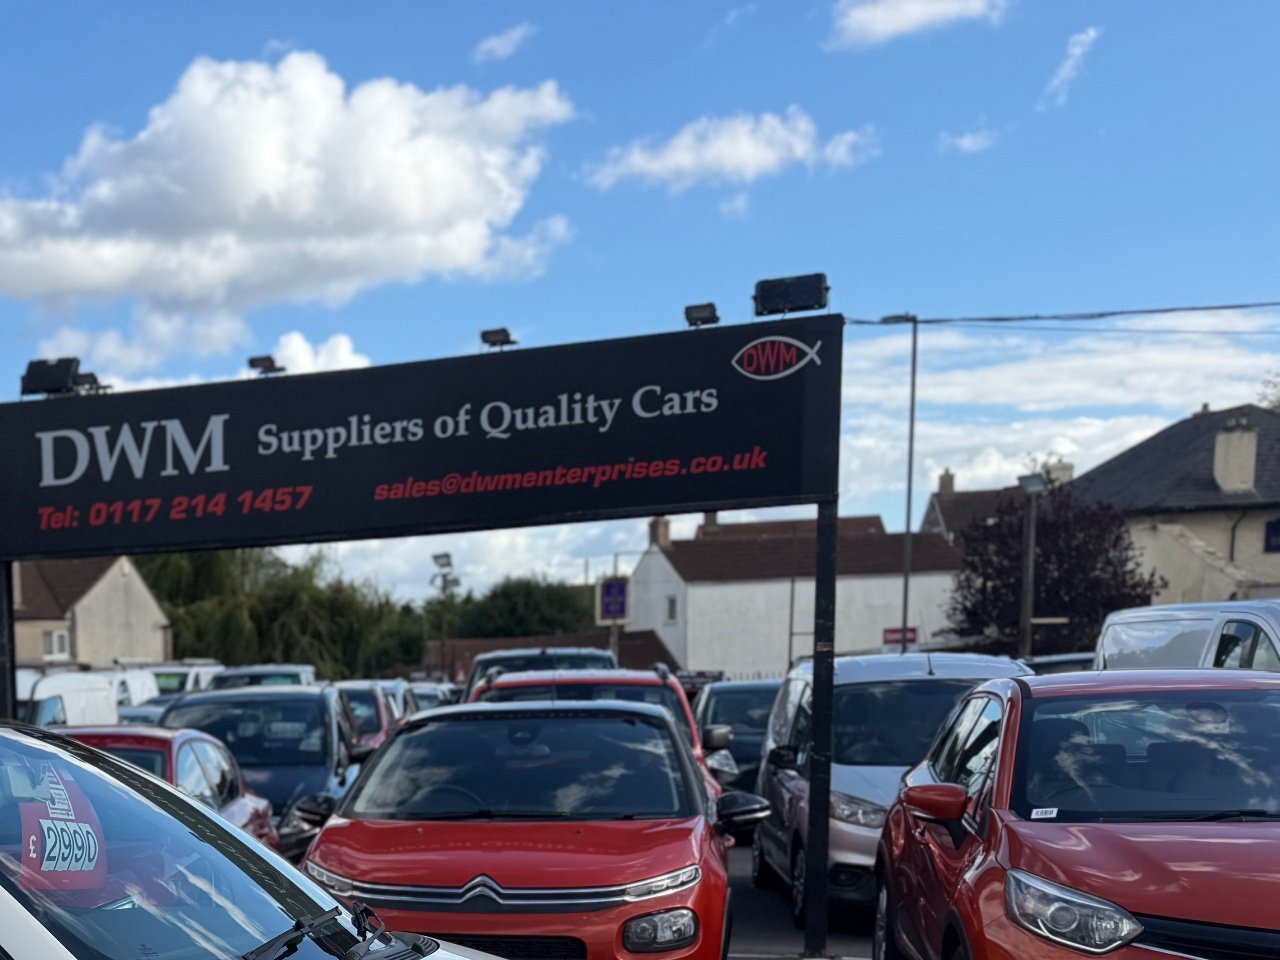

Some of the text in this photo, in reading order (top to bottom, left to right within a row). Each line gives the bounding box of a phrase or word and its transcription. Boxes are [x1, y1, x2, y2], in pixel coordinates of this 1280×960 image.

[743, 341, 797, 373] DWM
[257, 384, 719, 461] Suppliers of Quality Cars
[35, 413, 230, 488] DWM
[374, 445, 768, 501] sales@dwmenterprises.co.uk
[38, 485, 314, 530] Tel: 0117 214 1457
[46, 826, 97, 863] 2990
